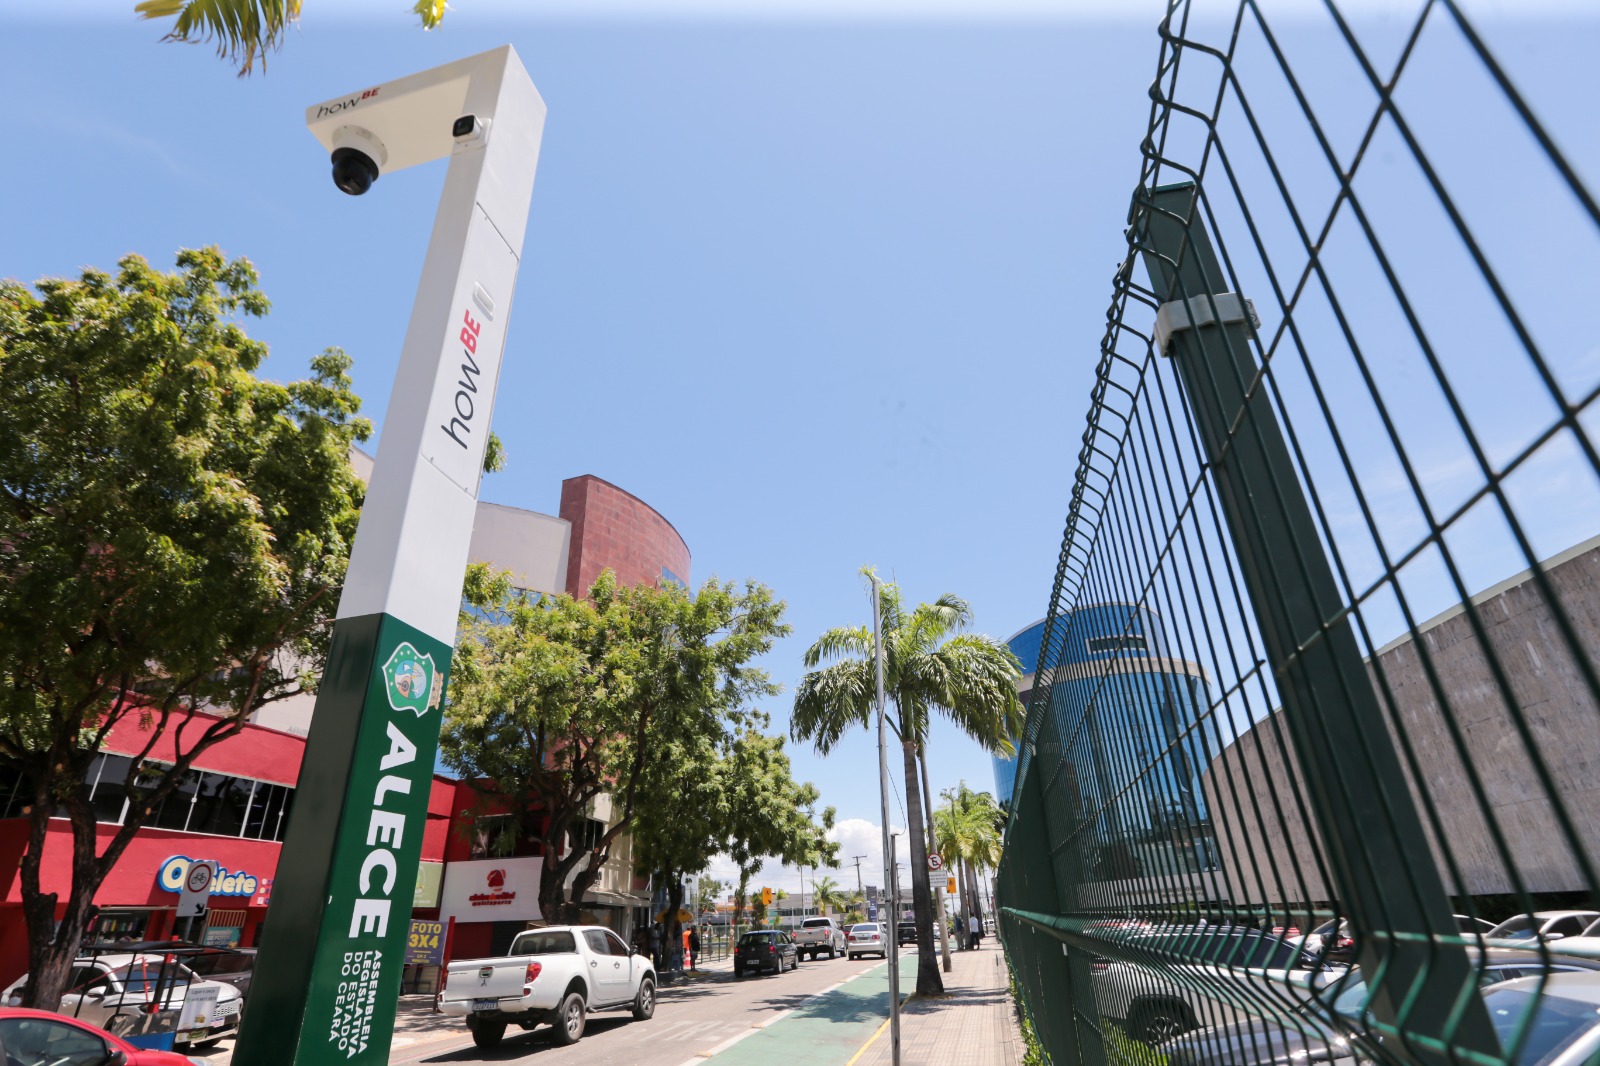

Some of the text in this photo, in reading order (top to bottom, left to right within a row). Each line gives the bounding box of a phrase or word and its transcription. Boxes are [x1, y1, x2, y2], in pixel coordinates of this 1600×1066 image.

[348, 720, 417, 938] ALECE
[341, 952, 353, 976] DO
[408, 933, 439, 949] 3X4
[411, 922, 442, 934] FOTO
[338, 952, 363, 1051] DO ESTADO
[346, 951, 373, 1059] LEGISLATIVA
[358, 949, 383, 1054] ASSEMBLEIA
